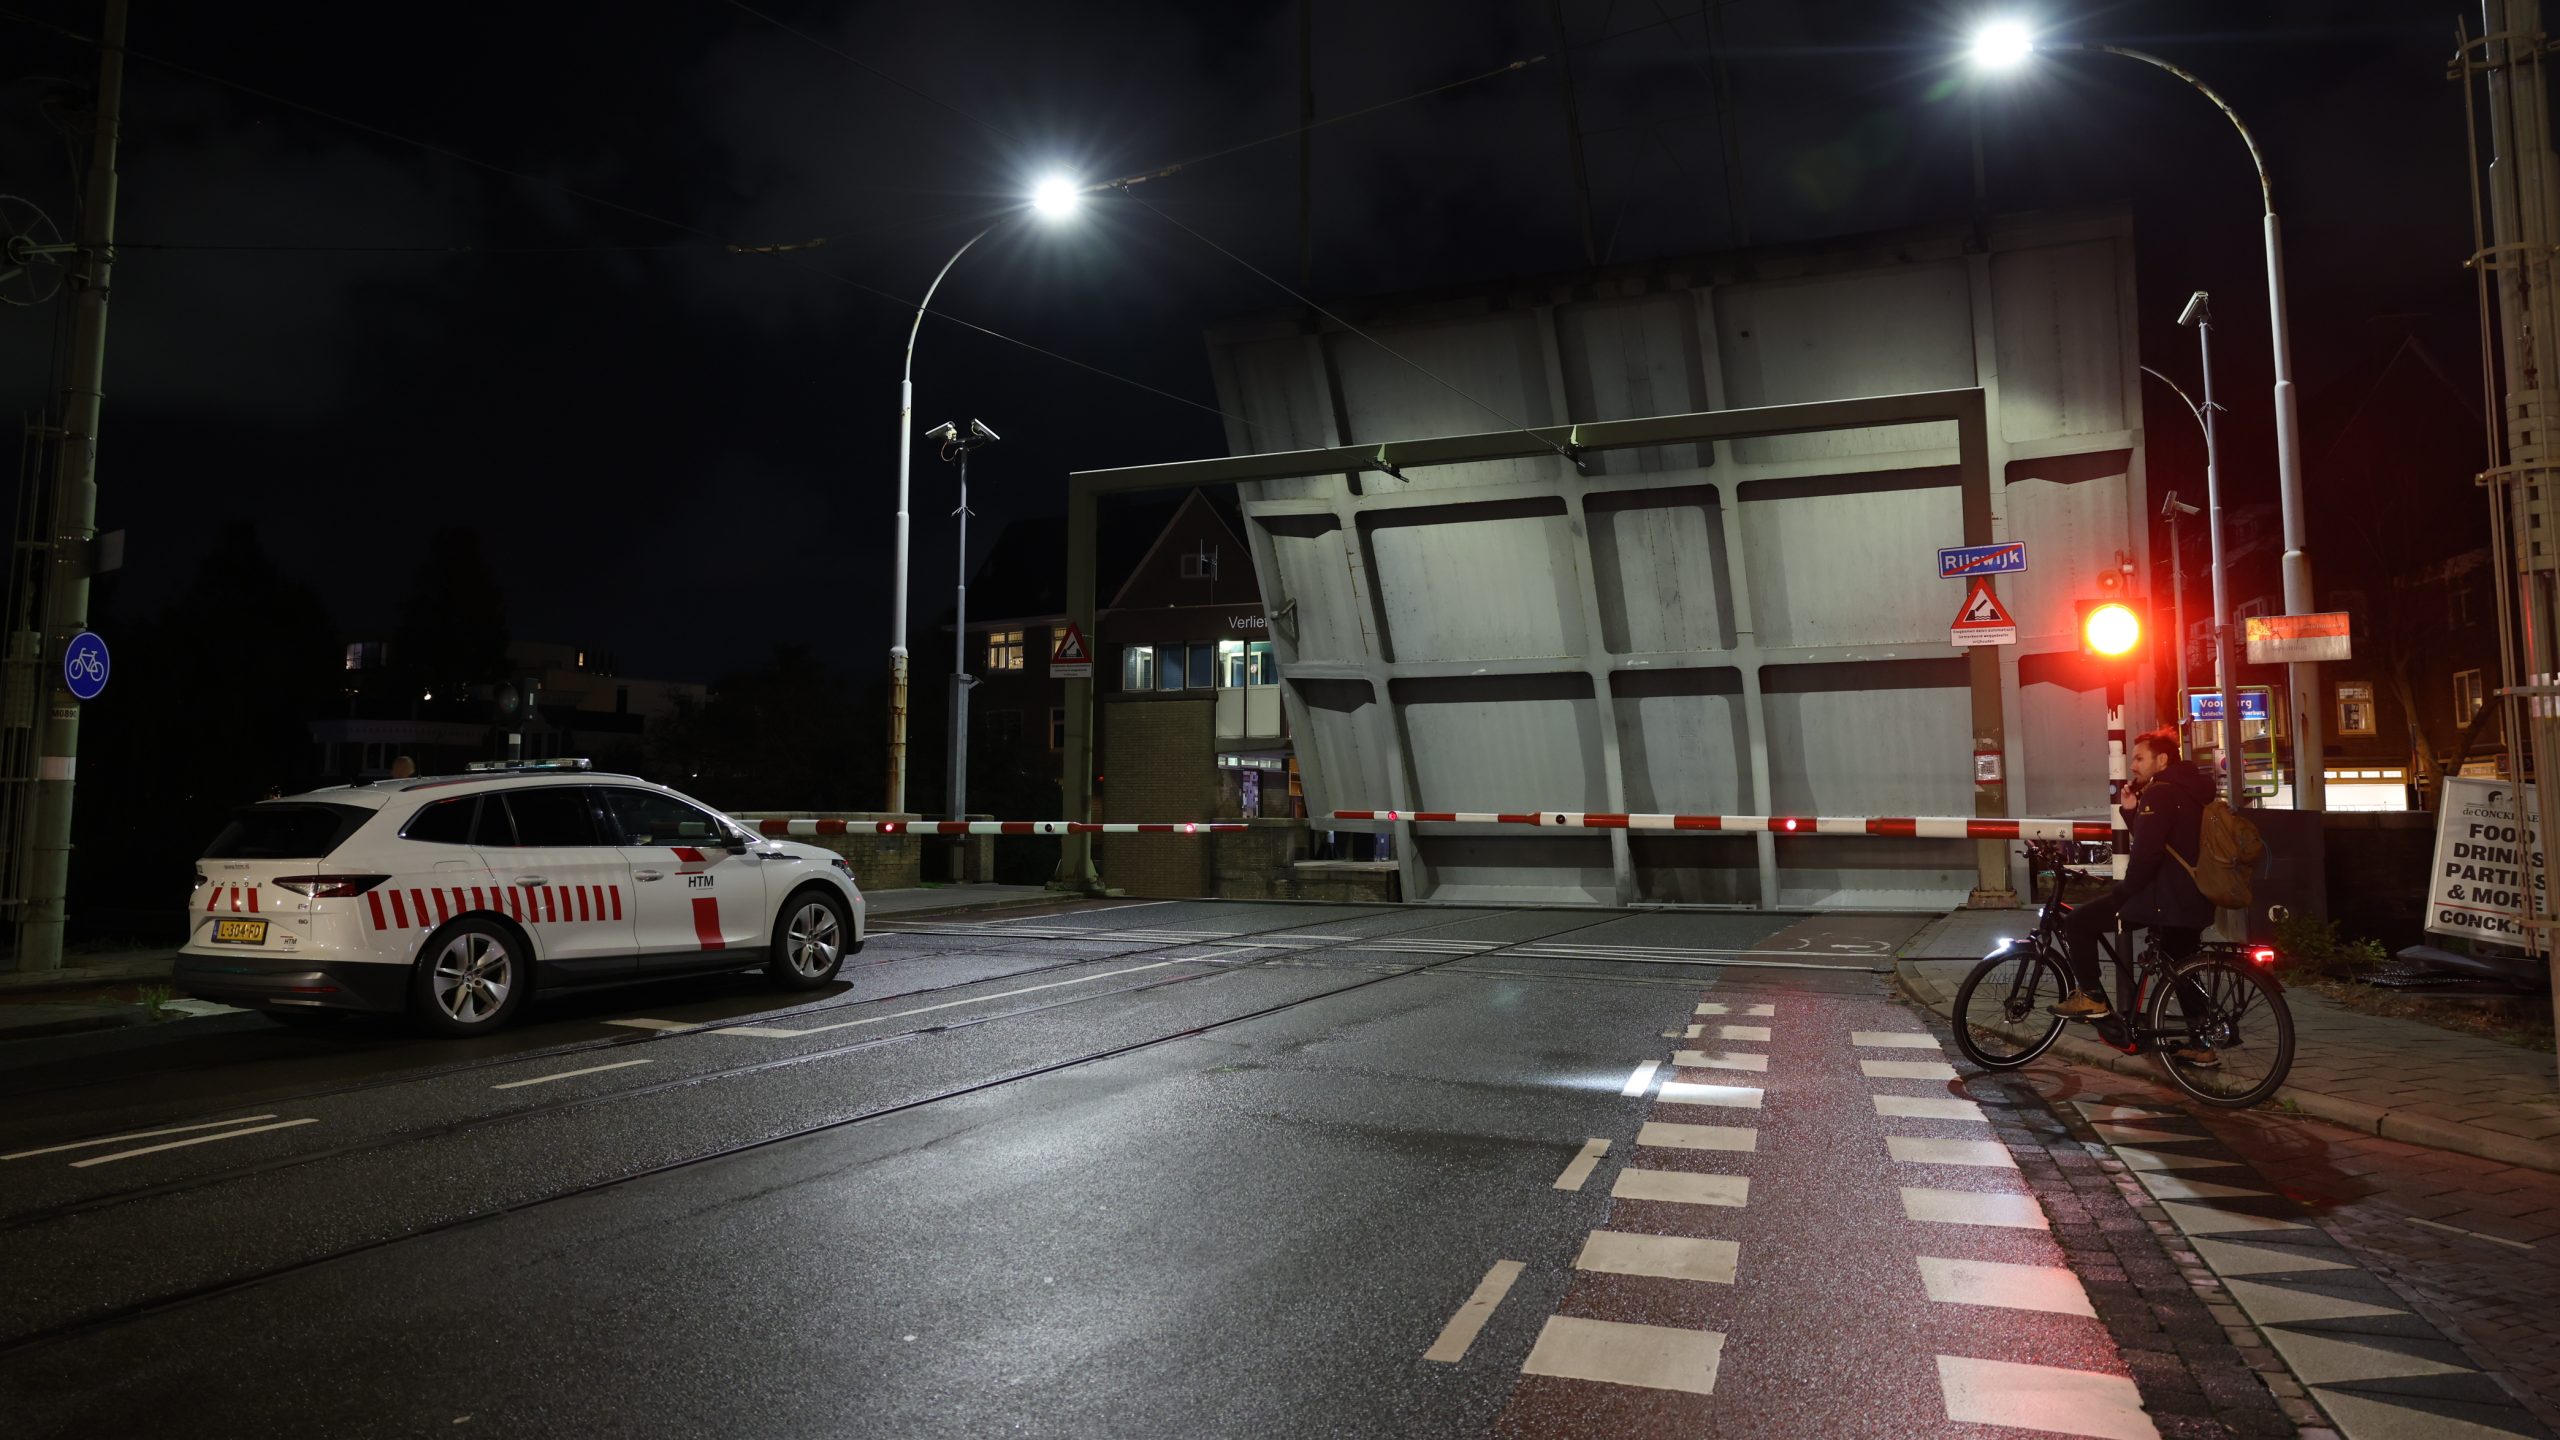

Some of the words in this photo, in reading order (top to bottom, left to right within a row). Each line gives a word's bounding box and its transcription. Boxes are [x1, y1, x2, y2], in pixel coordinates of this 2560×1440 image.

[1944, 550, 2020, 572] Rijswijk
[688, 875, 714, 888] HTM
[2447, 884, 2466, 900] &
